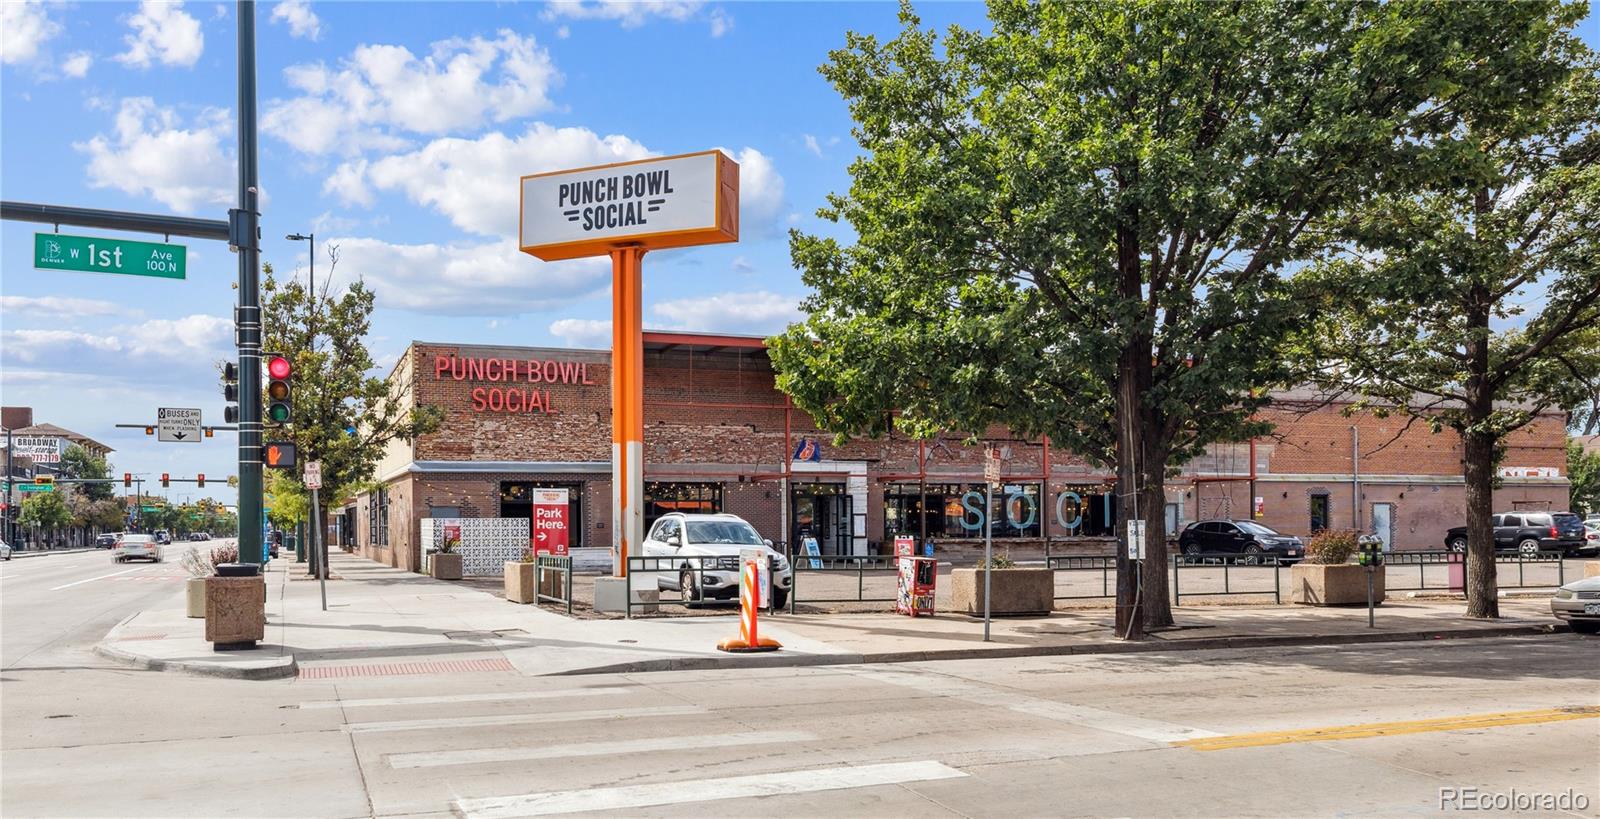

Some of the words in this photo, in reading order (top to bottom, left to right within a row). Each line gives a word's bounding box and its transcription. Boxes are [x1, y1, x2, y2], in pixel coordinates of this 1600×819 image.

[559, 176, 618, 208] PUNCH
[622, 169, 674, 199] BOWL
[583, 200, 647, 231] SOCIAL
[70, 248, 79, 259] W
[88, 243, 123, 268] 1st
[151, 249, 173, 261] Ave
[146, 260, 166, 272] 100
[169, 262, 177, 272] N
[434, 356, 518, 382] PUNCH
[526, 359, 594, 385] BOWL
[471, 386, 558, 413] SOCIAL
[167, 410, 190, 418] BUSES
[183, 418, 200, 426] ONLY
[17, 438, 58, 447] BROADWAY
[536, 507, 562, 518] Park
[536, 519, 567, 530] Here.
